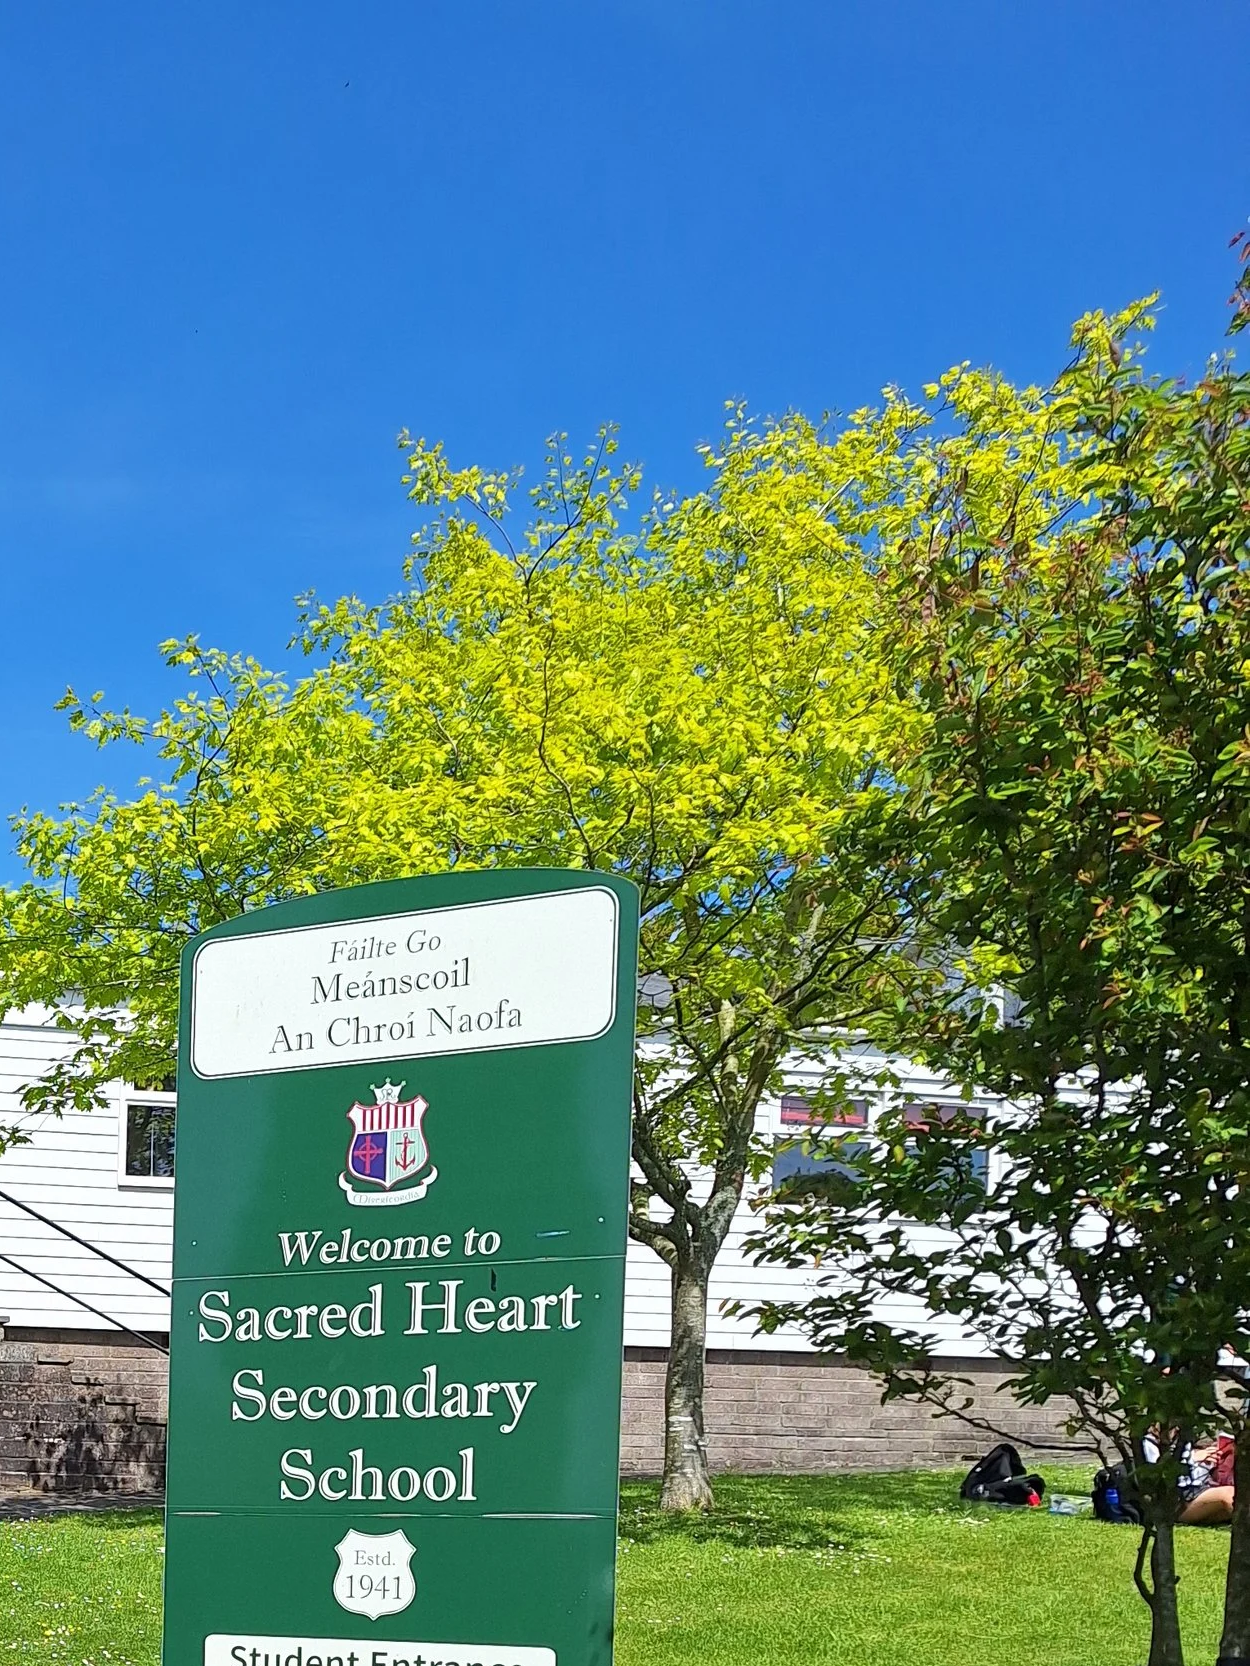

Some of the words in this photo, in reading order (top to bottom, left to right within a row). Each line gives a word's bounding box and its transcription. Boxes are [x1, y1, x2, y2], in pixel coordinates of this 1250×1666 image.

[328, 936, 398, 964] Fáilte
[406, 929, 442, 954] Go
[310, 957, 471, 1005] Meánscoil
[268, 1024, 314, 1054] An
[327, 1011, 415, 1048] Chroí
[426, 998, 523, 1037] Naofa
[278, 1229, 452, 1267] Welcome
[464, 1227, 501, 1256] to
[198, 1283, 386, 1343] Sacred
[403, 1279, 583, 1337] Heart
[232, 1364, 537, 1434] Secondary
[280, 1447, 478, 1502] School
[354, 1550, 396, 1567] Estd.
[345, 1574, 403, 1601] 1941
